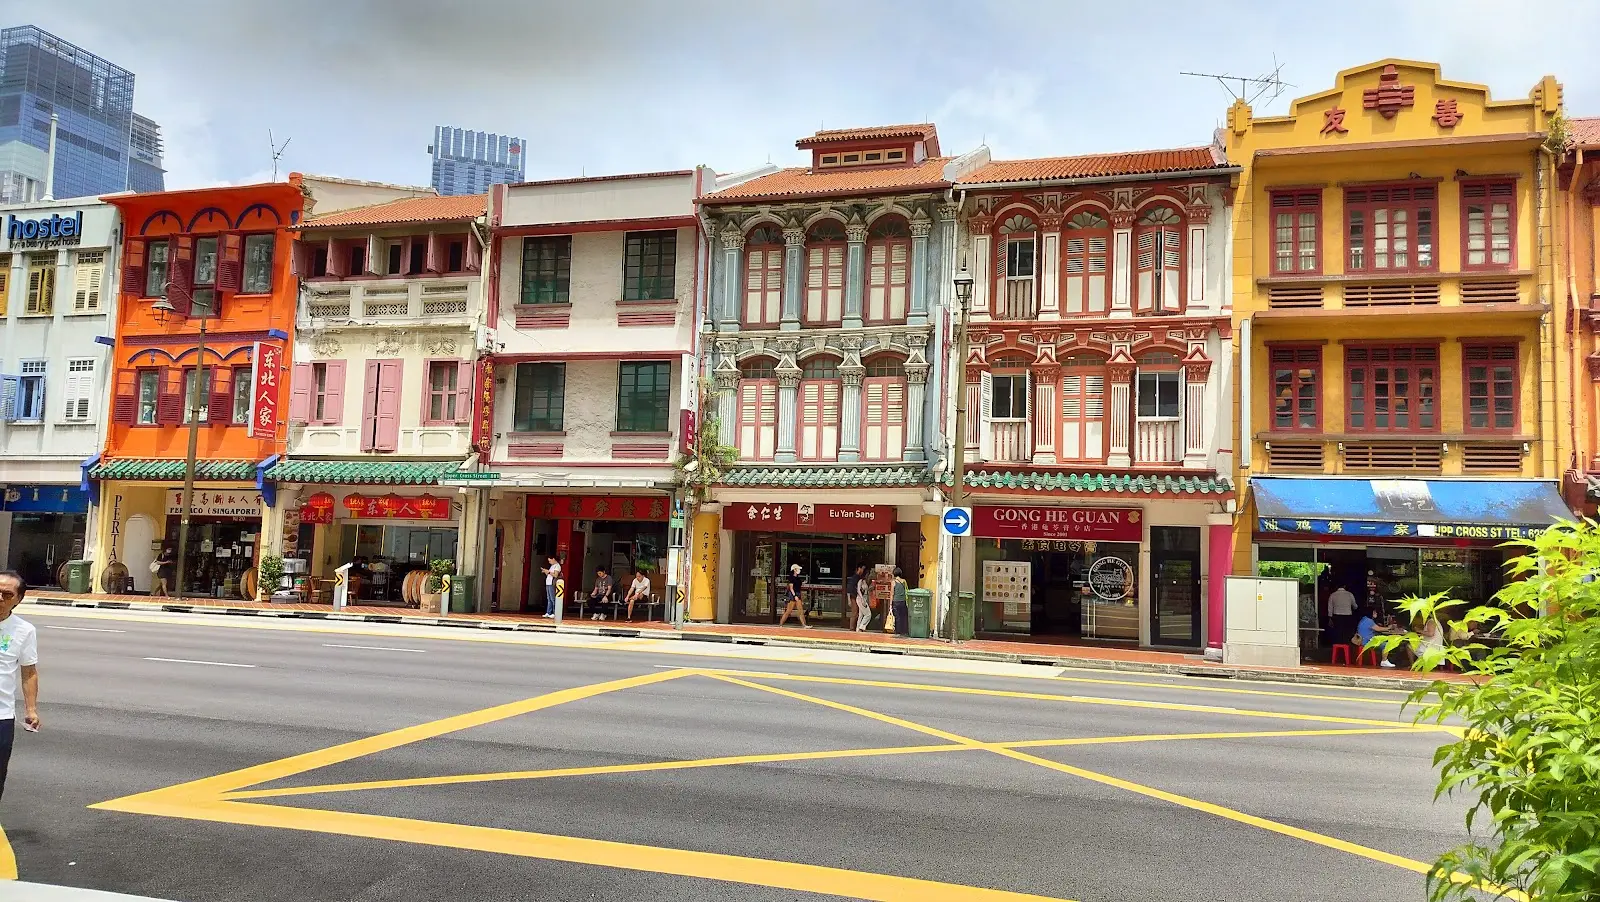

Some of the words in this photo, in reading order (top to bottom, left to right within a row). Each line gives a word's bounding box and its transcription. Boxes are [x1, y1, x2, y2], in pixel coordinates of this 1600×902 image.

[7, 210, 83, 239] hostel
[258, 349, 276, 427] 东北人家
[746, 504, 783, 521] 余仁生
[829, 509, 840, 518] Eu
[840, 509, 854, 518] Yan
[855, 510, 875, 520] Sang
[993, 508, 1041, 521] GONG
[1045, 510, 1068, 522] HE
[1072, 510, 1120, 523] GUAN
[1264, 519, 1410, 536] 油鸡第一家
[1455, 526, 1489, 538] CROSS
[1490, 527, 1503, 538] ST
[1505, 528, 1526, 538] TEL:
[1092, 560, 1107, 572] GONG
